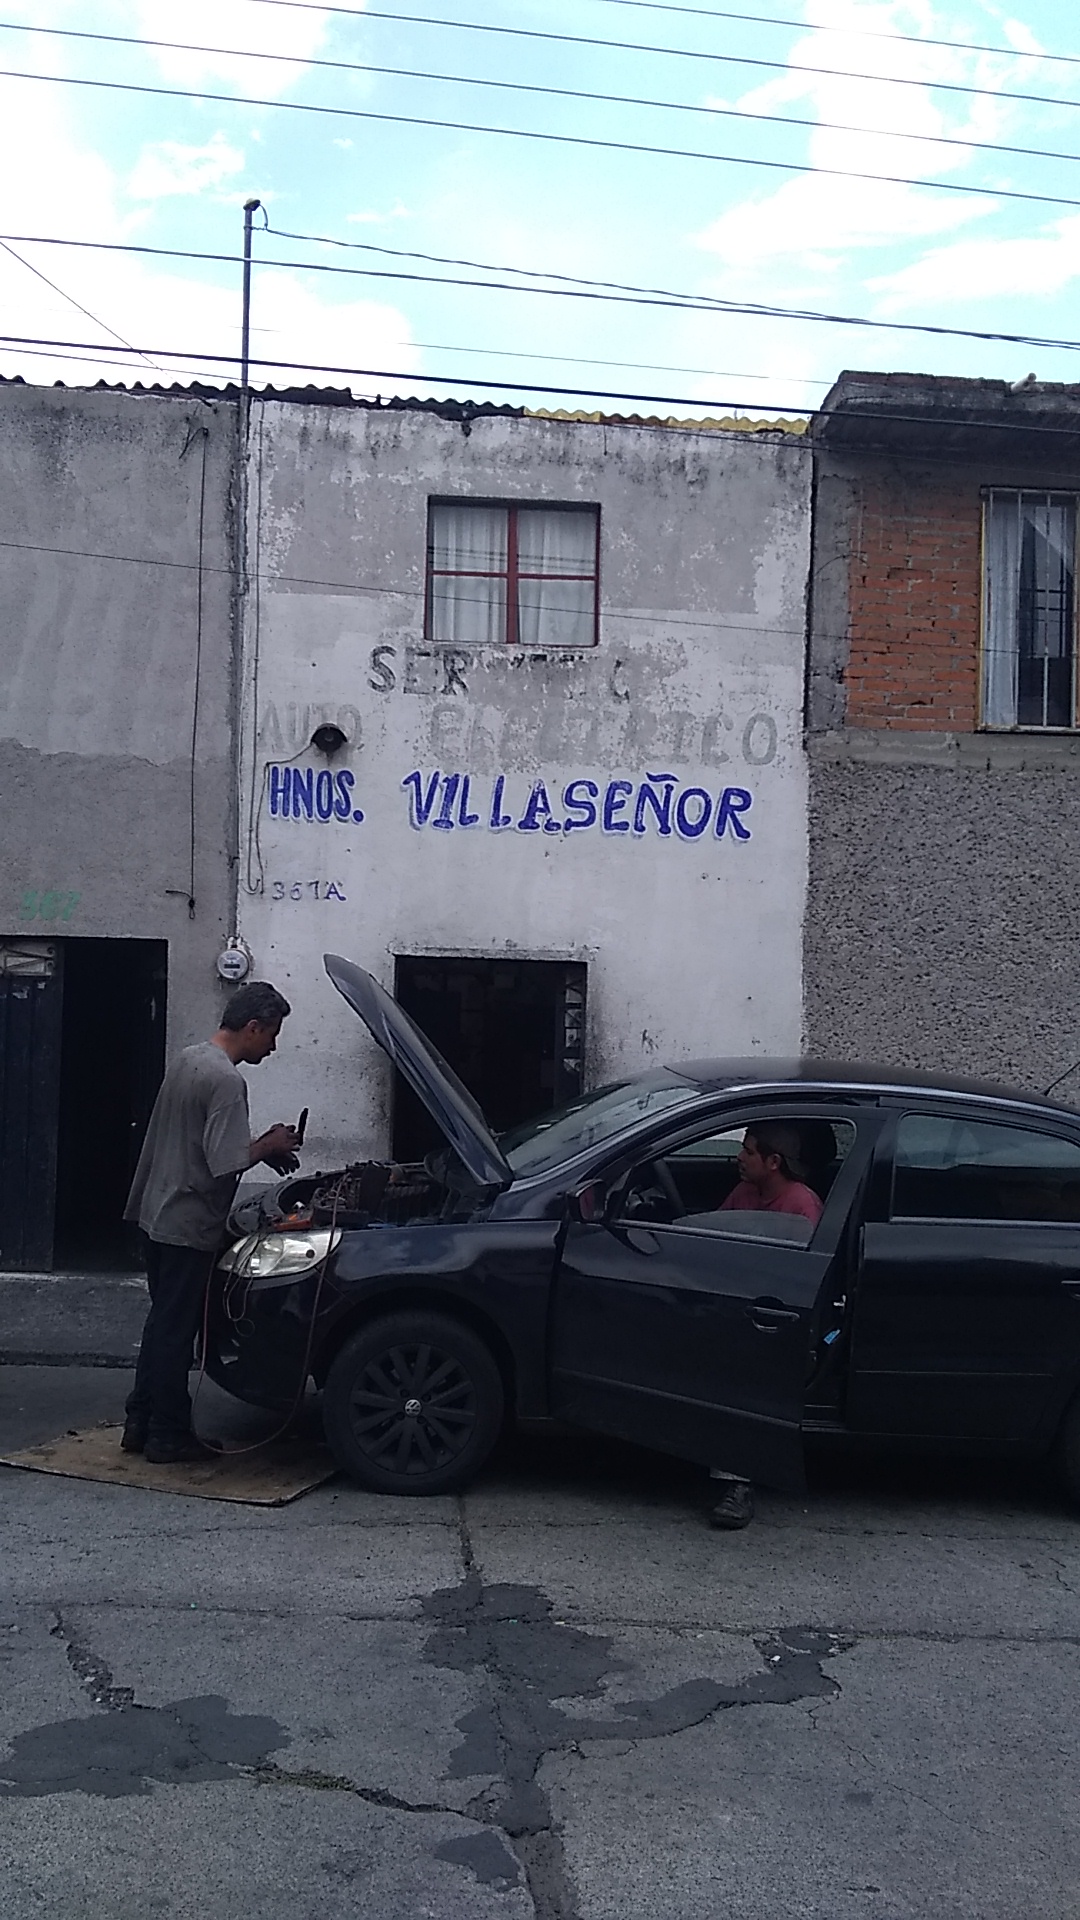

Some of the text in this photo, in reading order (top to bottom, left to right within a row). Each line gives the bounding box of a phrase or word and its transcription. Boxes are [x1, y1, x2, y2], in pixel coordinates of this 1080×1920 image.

[269, 766, 753, 841] HNOS. VILLASEÑOR
[272, 880, 347, 901] 367A
